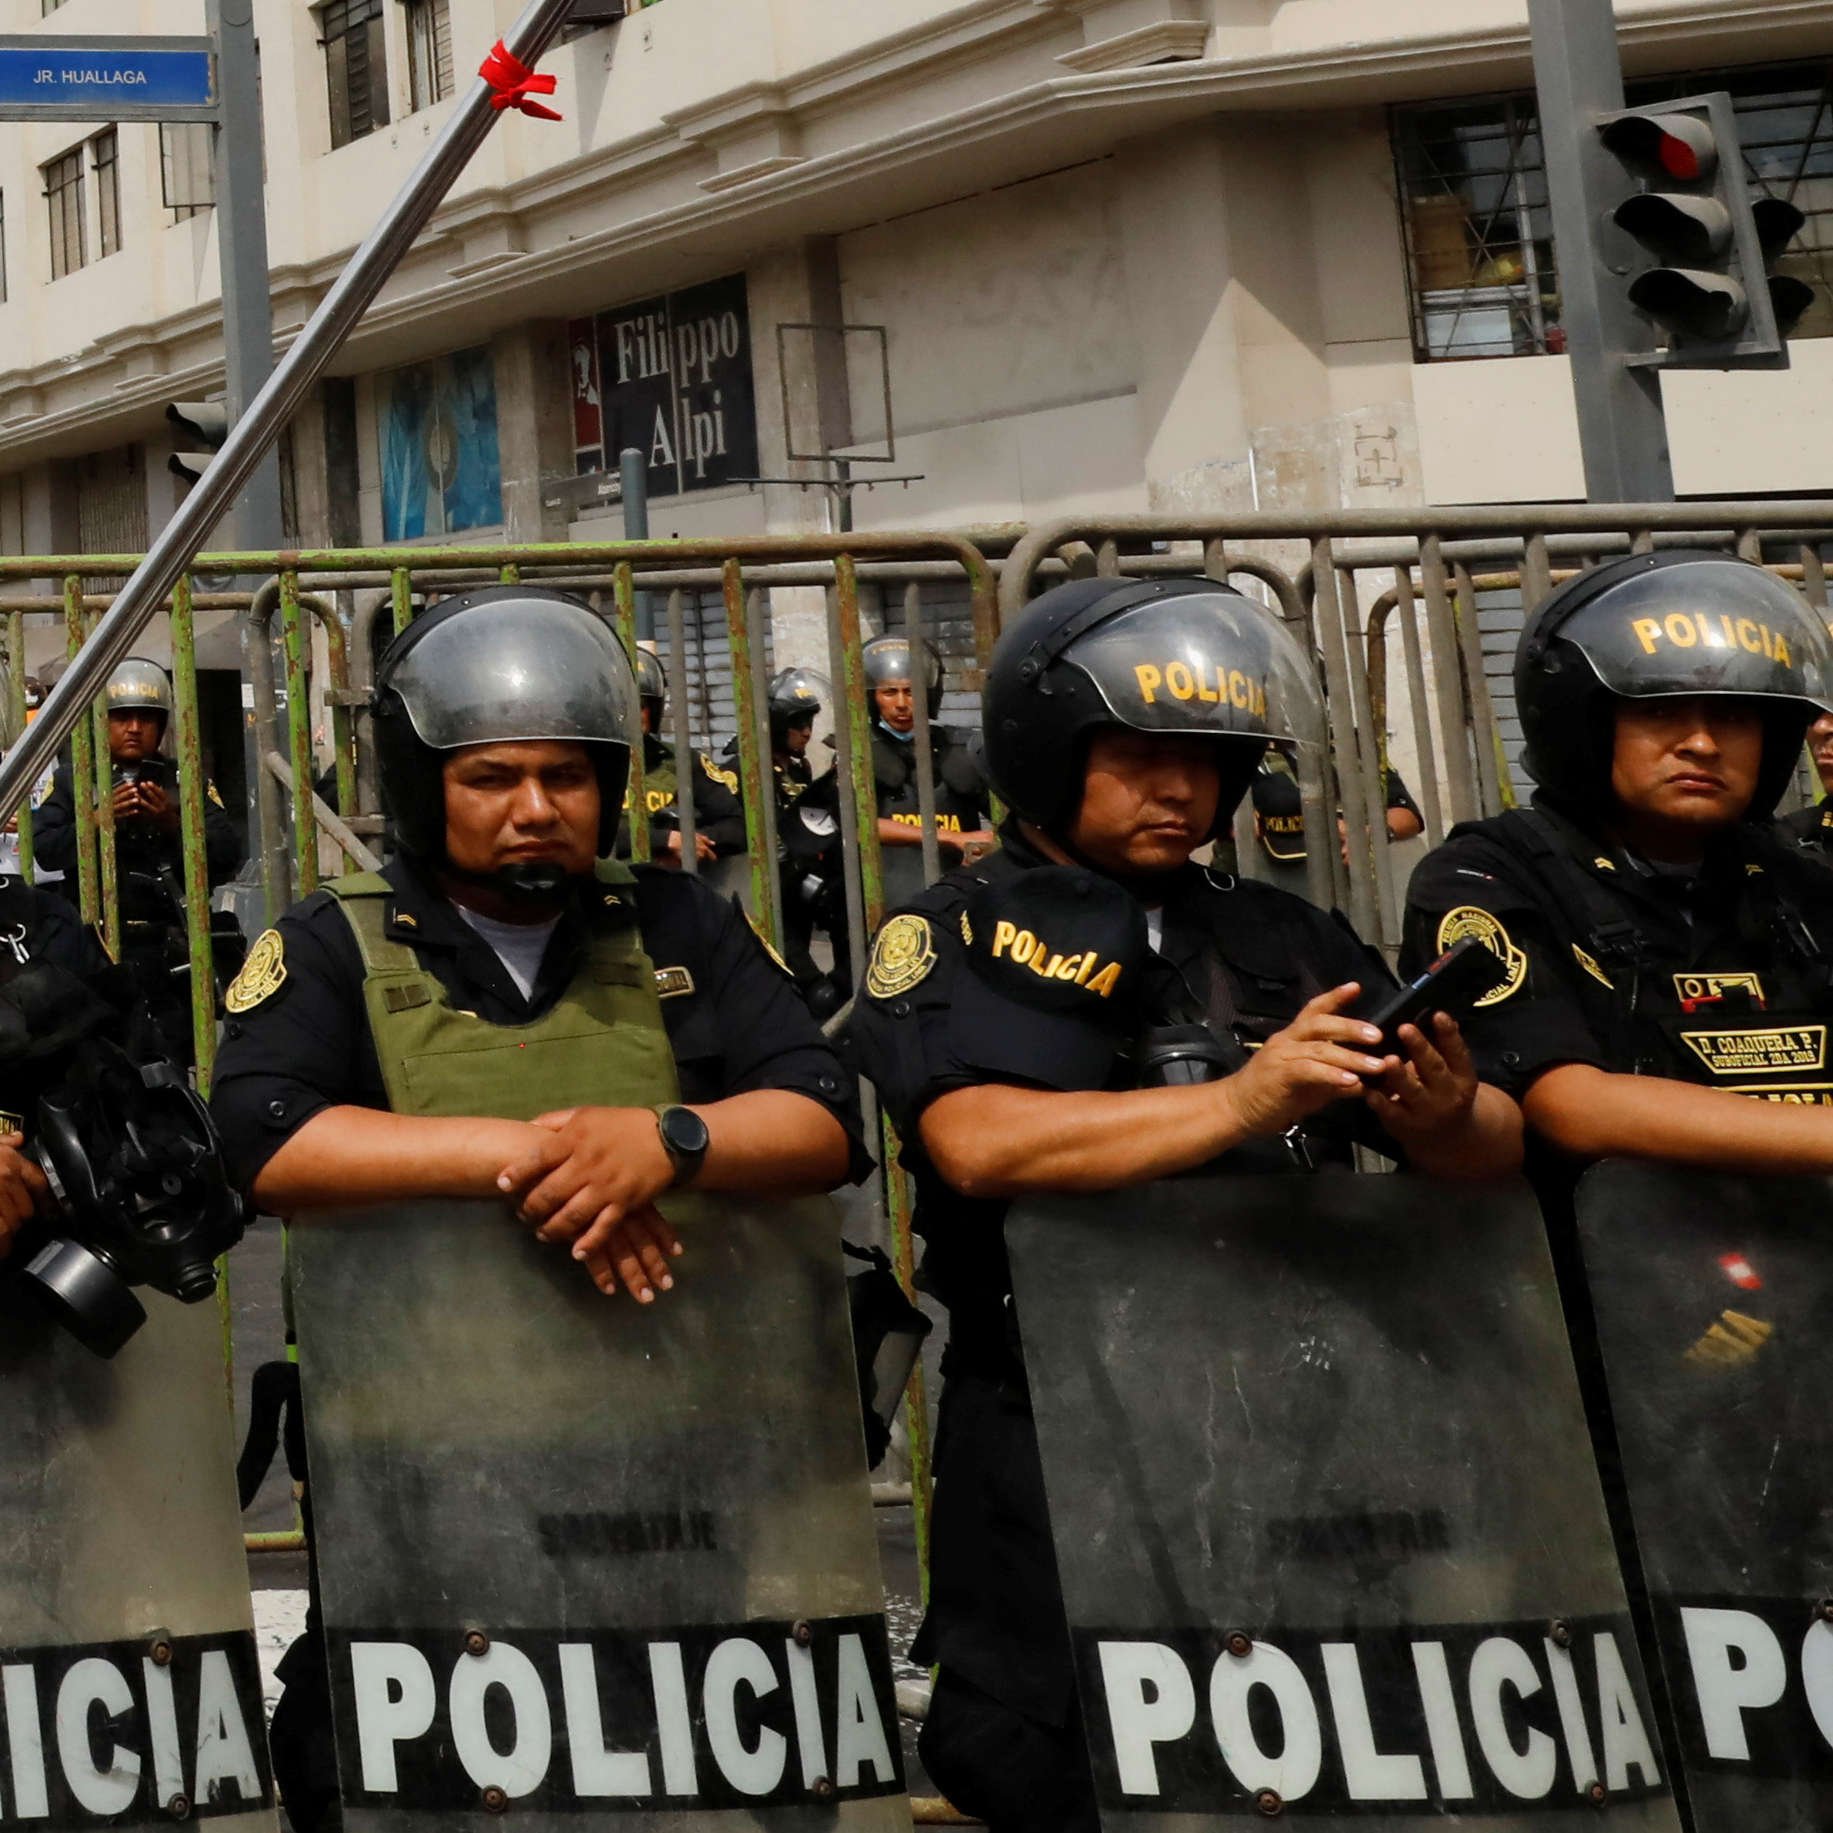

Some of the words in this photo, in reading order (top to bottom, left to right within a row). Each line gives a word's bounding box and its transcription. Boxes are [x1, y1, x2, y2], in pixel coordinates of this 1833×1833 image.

[33, 70, 57, 84] JR.
[61, 70, 148, 84] HUALLAGA
[614, 310, 739, 388] Filippo
[648, 389, 727, 479] Alpi
[1631, 612, 1793, 670] POLICIA
[1134, 660, 1266, 719] POLICIA
[1698, 1037, 1715, 1054] D.
[1717, 1034, 1798, 1054] COAQUERA
[1799, 1032, 1818, 1050] P.
[1711, 1053, 1768, 1068] SUBOFICIAL
[349, 1632, 897, 1799] POLICIA
[1096, 1631, 1662, 1803] POLICIA
